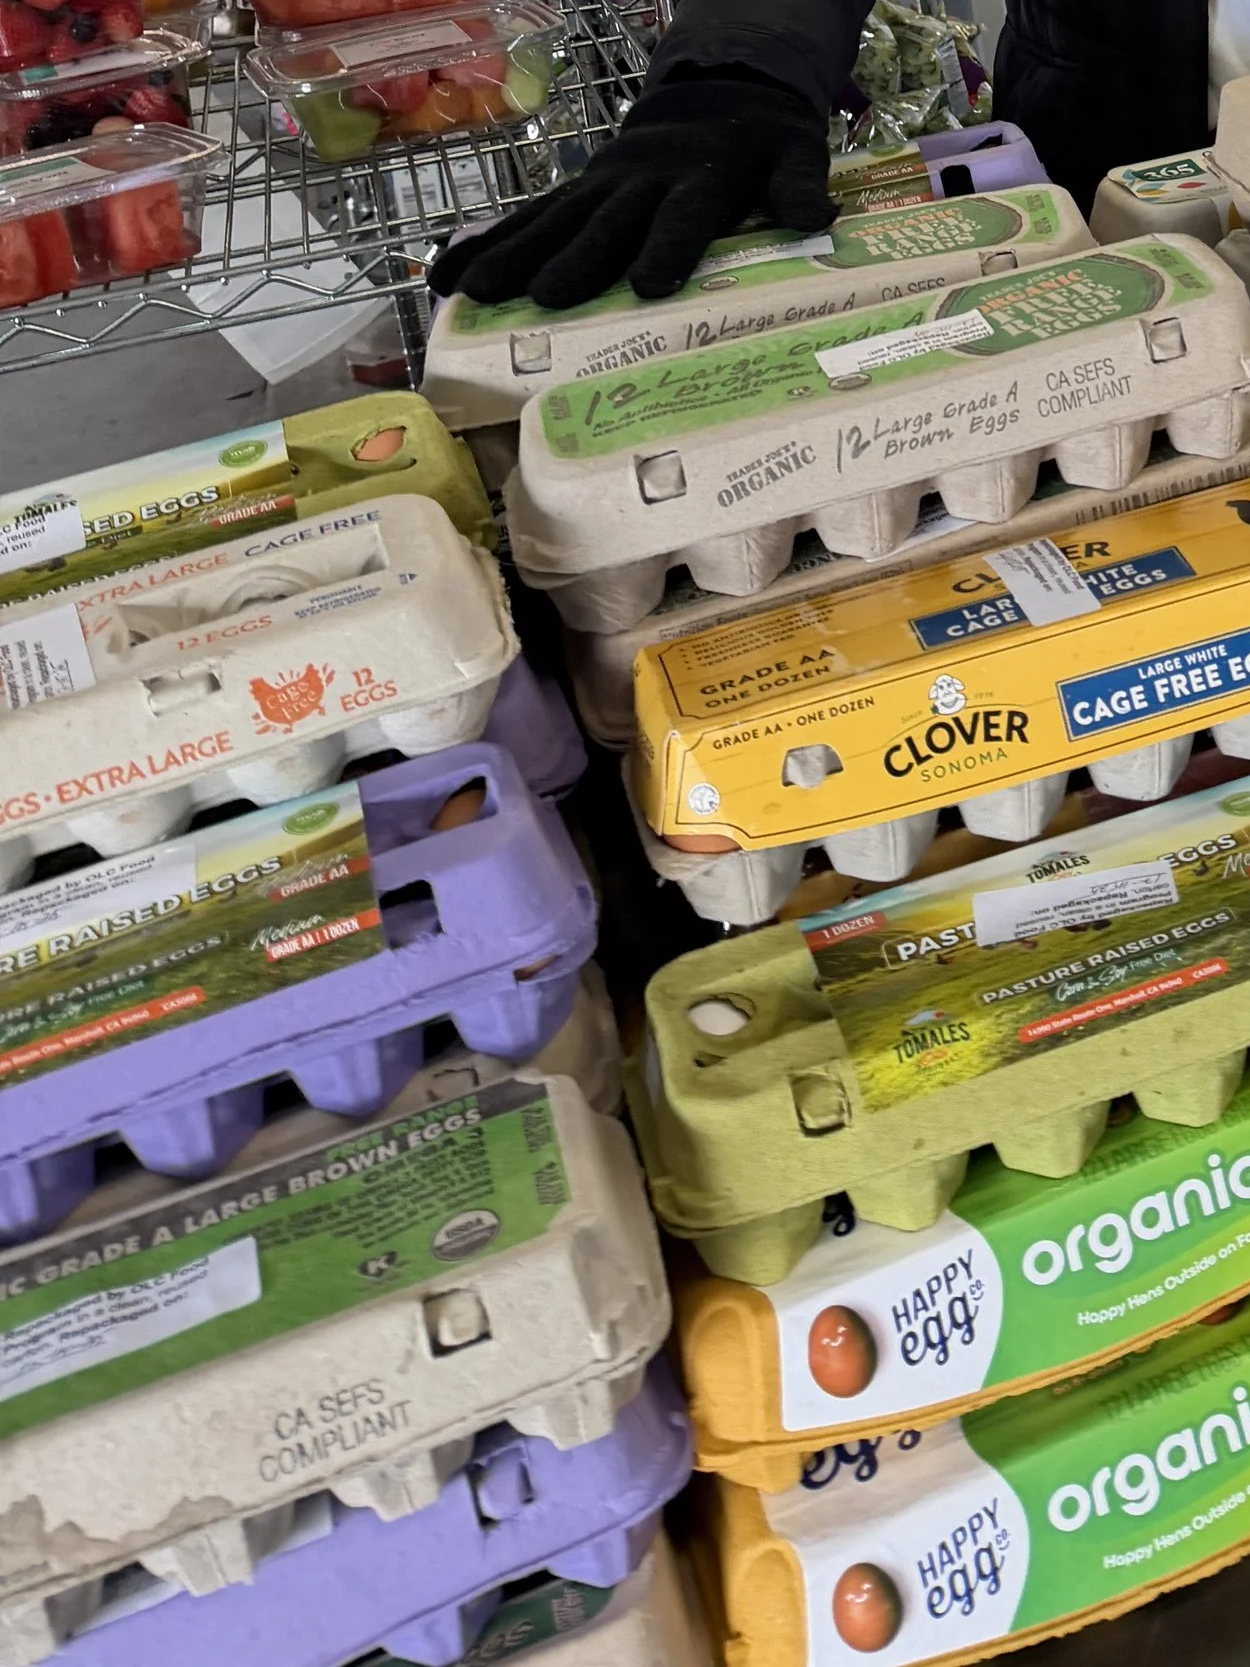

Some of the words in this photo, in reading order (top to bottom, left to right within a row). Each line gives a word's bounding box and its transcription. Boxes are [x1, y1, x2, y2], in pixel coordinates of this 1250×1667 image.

[685, 320, 717, 351] 12
[719, 315, 775, 336] Large
[784, 302, 836, 321] Grade
[842, 292, 856, 311] A
[586, 343, 619, 362] TRADER
[1045, 371, 1070, 394] CA
[1073, 357, 1116, 385] SEFS
[835, 424, 872, 474] 12
[873, 411, 933, 442] Large
[943, 391, 998, 421] Grade
[1006, 380, 1019, 404] A
[1037, 374, 1132, 419] COMPLIANT
[884, 427, 954, 460] Brown
[969, 409, 1021, 438] Eggs
[716, 444, 818, 508] ORGANIC
[726, 459, 763, 483] TRADER
[140, 485, 220, 522] EGGS
[147, 553, 230, 591] LARGE
[244, 530, 312, 557] CAGE
[319, 510, 381, 534] FREE
[207, 615, 274, 645] EGGS
[352, 667, 375, 687] 12
[700, 660, 790, 696] GRADE
[799, 647, 835, 666] AA
[704, 688, 749, 710] ONE
[757, 664, 831, 693] DOZEN
[1138, 656, 1183, 680] LARGE
[1184, 645, 1229, 668] WHITE
[339, 680, 399, 714] EGGS
[712, 729, 759, 751] GRADE
[763, 723, 783, 738] AA
[796, 709, 827, 729] ONE
[829, 696, 876, 718] DOZEN
[1072, 686, 1149, 726] CAGE
[1155, 662, 1224, 705] FREE
[57, 764, 145, 804] EXTRA
[149, 730, 235, 781] LARGE
[883, 710, 1030, 779] CLOVER
[921, 748, 1008, 783] SONOMA
[1025, 854, 1092, 884] TOMALES
[50, 894, 182, 956] RAISED
[191, 856, 284, 904] EGGS
[981, 962, 1087, 1005] PASTURE
[1092, 931, 1174, 967] RAISED
[1178, 909, 1231, 939] EGGS
[892, 1020, 971, 1063] TOMALES
[35, 1235, 141, 1288] GRADE
[153, 1225, 175, 1246] A
[183, 1185, 278, 1236] LARGE
[288, 1141, 400, 1195] BROWN
[407, 1108, 482, 1149] EGGS
[890, 1248, 976, 1335] HAPPY
[1077, 1299, 1126, 1328] Happy
[1127, 1282, 1165, 1310] Hens
[1164, 1251, 1218, 1291] Outside
[1218, 1241, 1237, 1260] on
[899, 1286, 982, 1368] egg
[274, 1403, 312, 1442] CA
[318, 1379, 386, 1424] SEFS
[258, 1400, 413, 1483] COMPLIANT
[916, 1497, 1002, 1589] HAPPY
[1103, 1543, 1155, 1571] Happy
[1153, 1525, 1195, 1555] Hens
[1191, 1488, 1248, 1534] Outside
[925, 1536, 1013, 1621] egg
